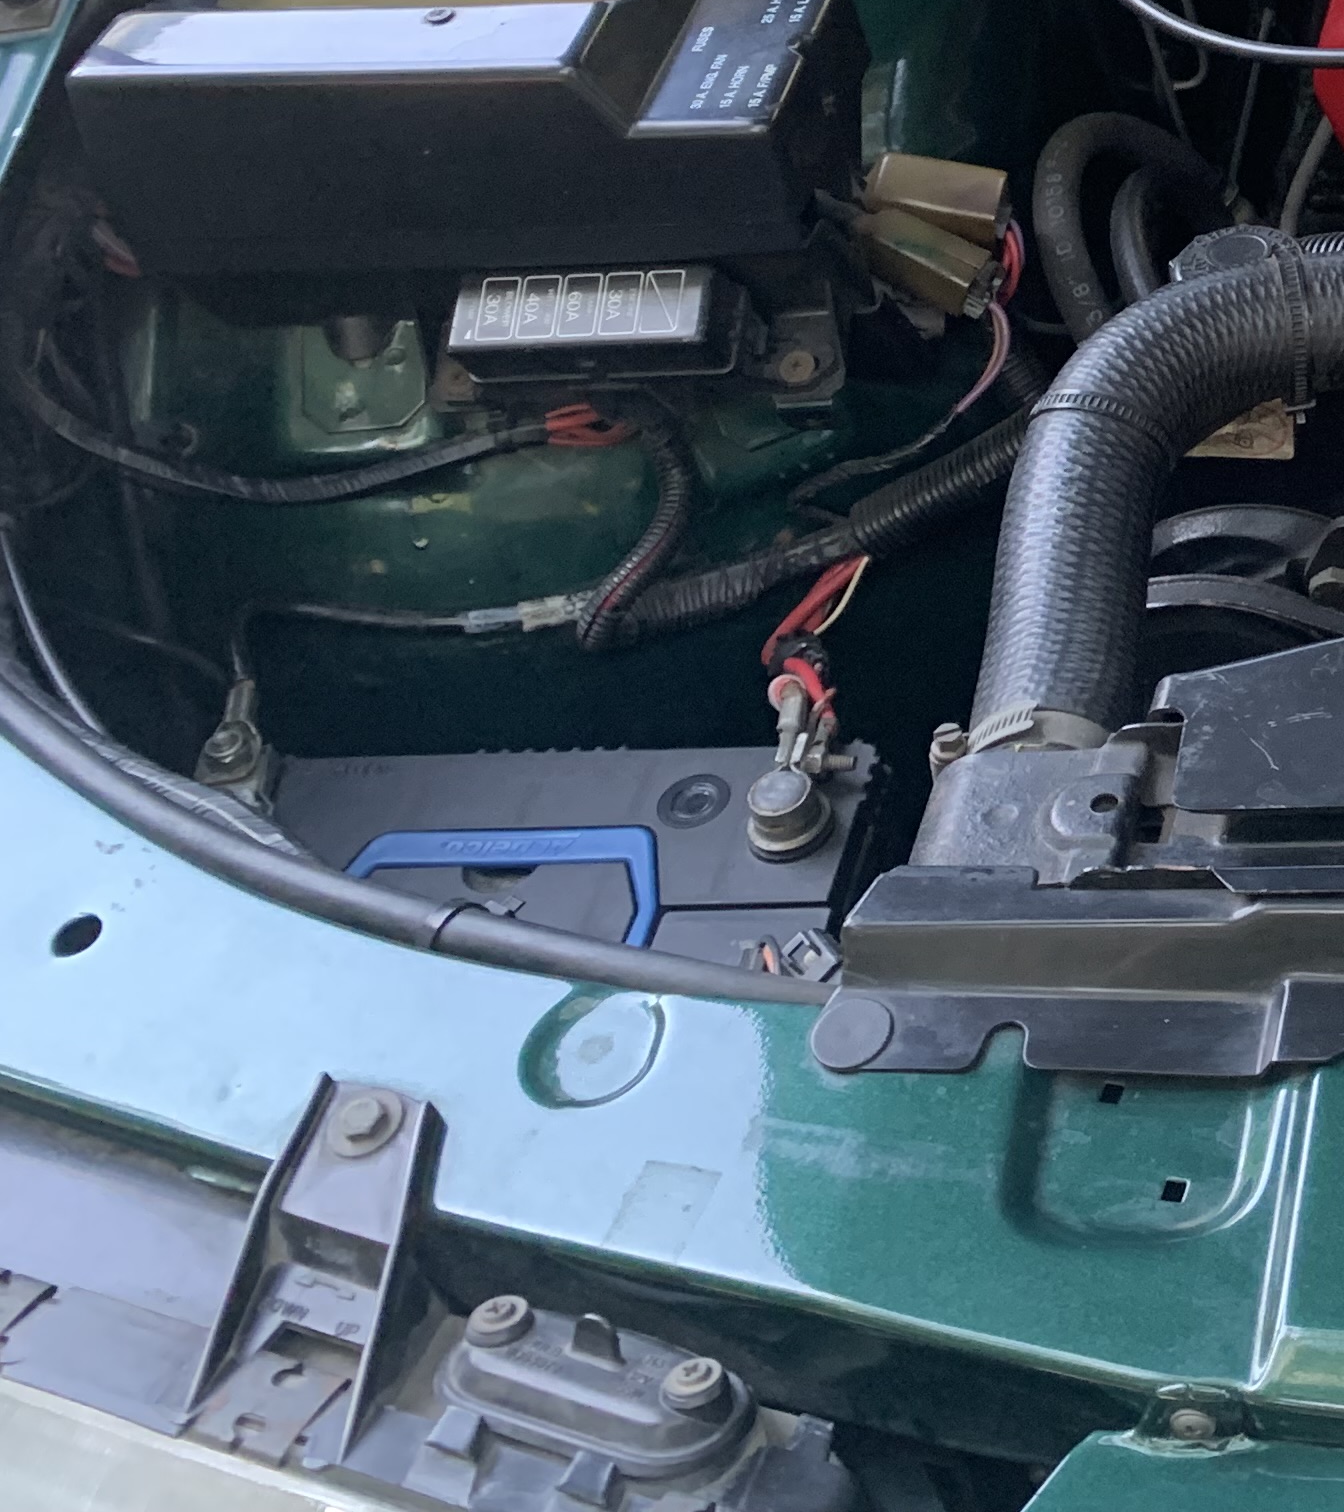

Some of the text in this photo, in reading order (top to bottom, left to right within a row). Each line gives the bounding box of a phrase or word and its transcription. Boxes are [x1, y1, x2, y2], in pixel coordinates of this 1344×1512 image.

[691, 26, 715, 52] FUSES
[719, 99, 733, 108] 15
[728, 65, 750, 89] HORN
[747, 98, 762, 108] 15
[482, 293, 501, 326] 30A
[522, 292, 541, 325] 40A
[565, 290, 582, 322] 60A
[605, 289, 623, 321] 30A
[335, 1320, 361, 1336] UP
